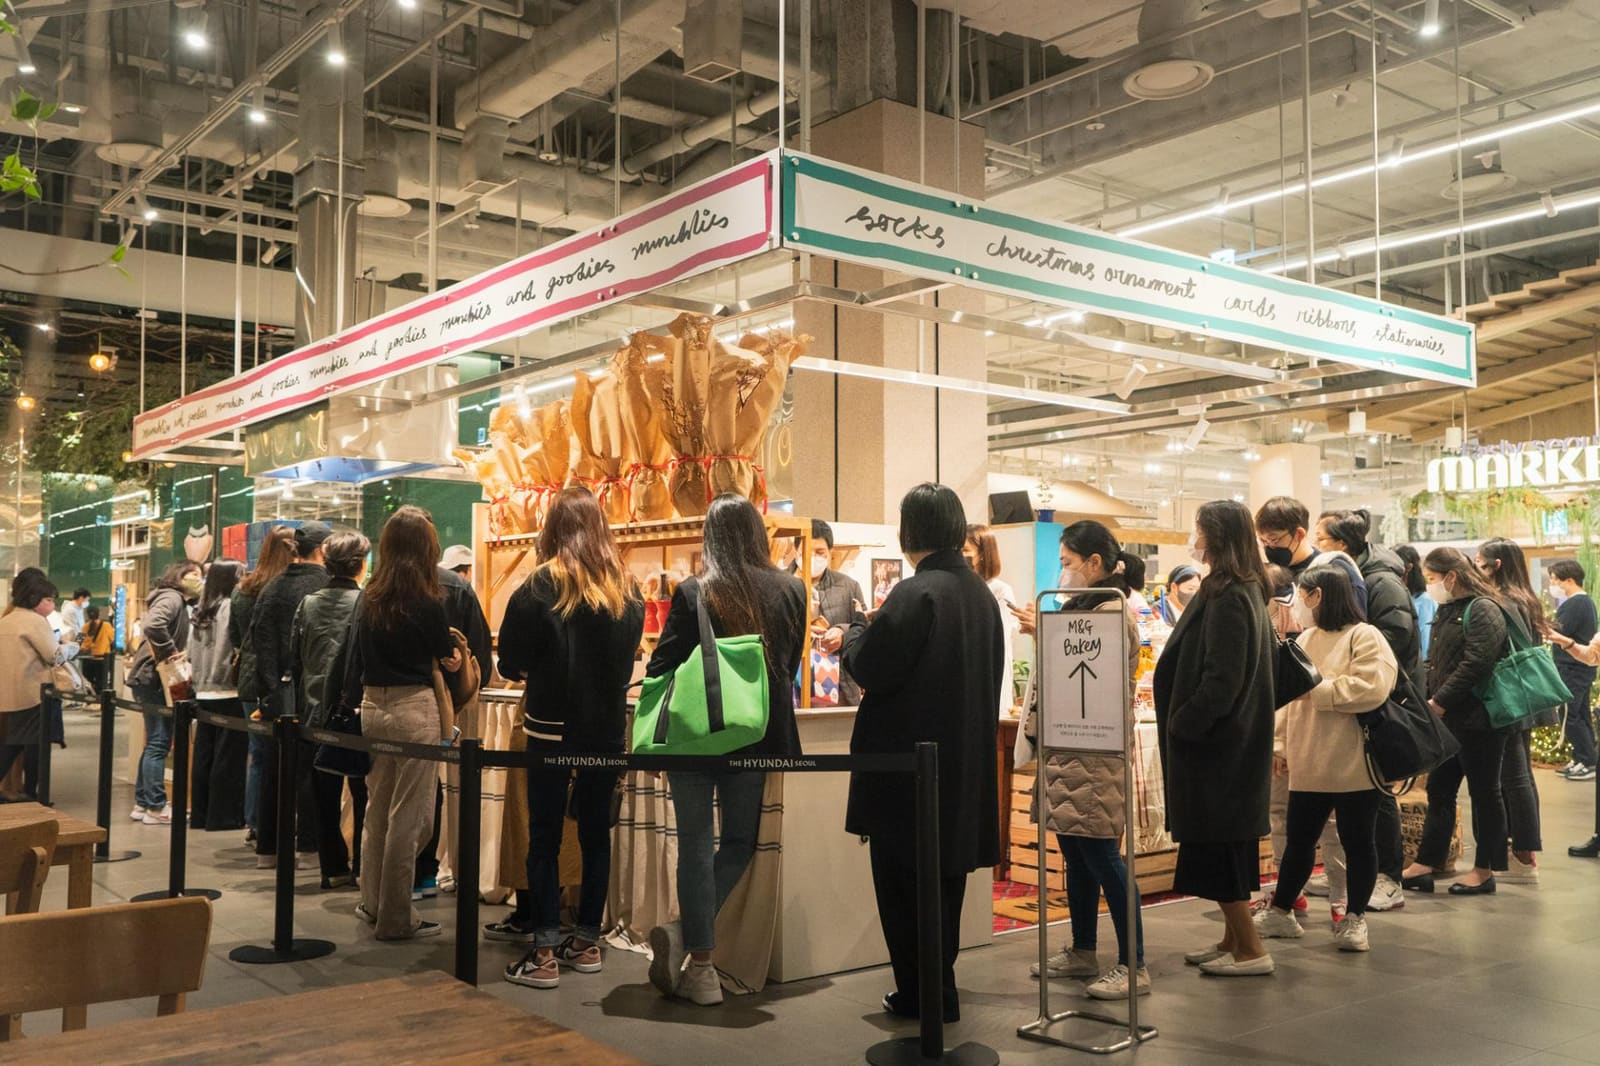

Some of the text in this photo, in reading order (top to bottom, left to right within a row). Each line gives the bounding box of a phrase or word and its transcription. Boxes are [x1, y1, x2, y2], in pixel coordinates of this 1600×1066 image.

[844, 205, 946, 249] socks
[986, 234, 1096, 281] christmas
[1103, 267, 1198, 299] ornament
[1223, 297, 1277, 321] cards
[1296, 307, 1357, 339] ribbons
[356, 339, 378, 363] and
[384, 326, 428, 360] goodies
[440, 301, 492, 336] munchies
[505, 280, 537, 307] and
[545, 257, 616, 299] goodies
[631, 208, 729, 261] munchies
[1068, 618, 1093, 636] M&G
[558, 756, 606, 766] HYUNDAI
[743, 758, 793, 768] HYUNDAI
